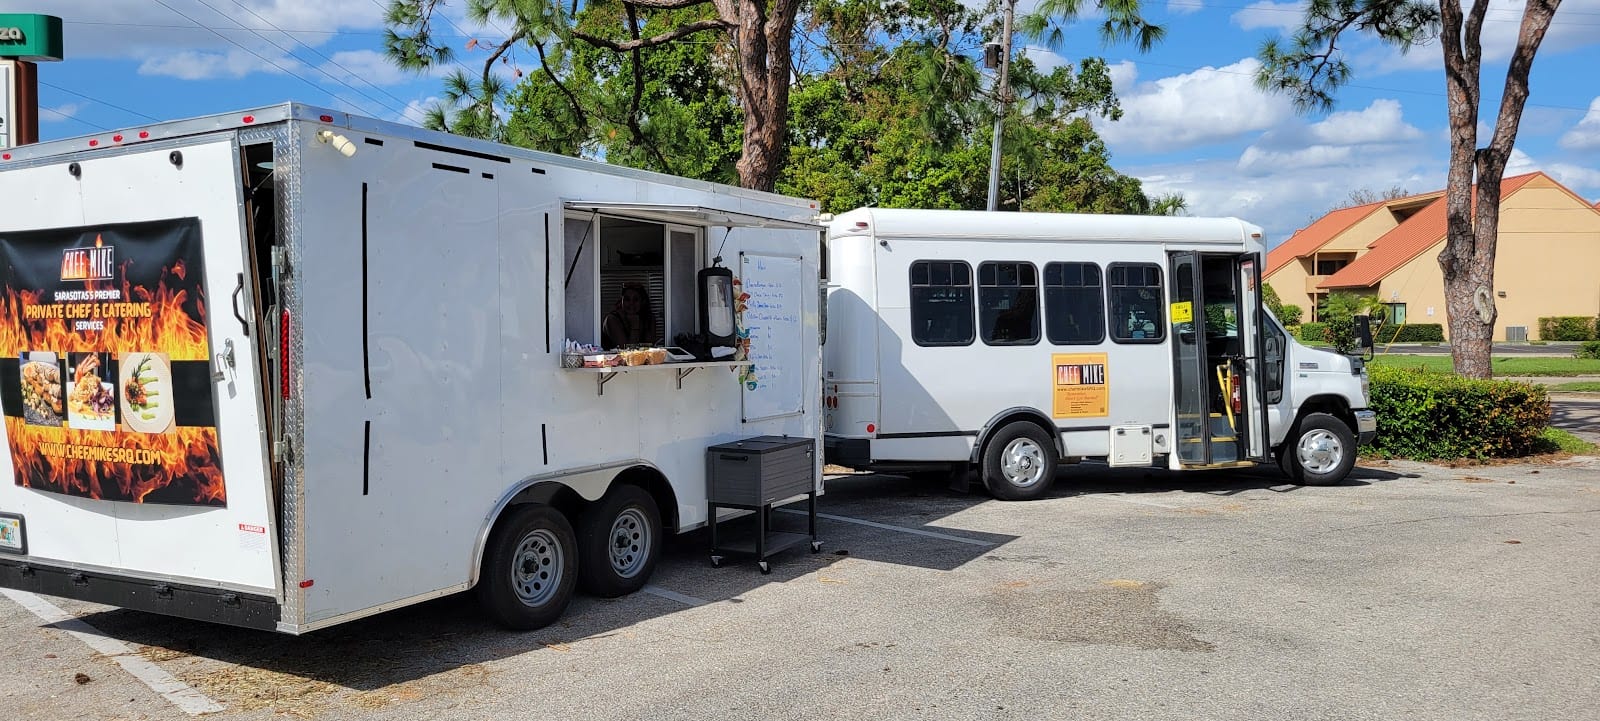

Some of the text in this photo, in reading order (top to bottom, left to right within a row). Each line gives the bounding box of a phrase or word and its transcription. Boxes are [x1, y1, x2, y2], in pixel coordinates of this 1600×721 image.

[89, 248, 113, 277] MIKE
[94, 289, 121, 300] PREMIER
[26, 302, 152, 319] PRIVATE CHEF & CATERING
[75, 320, 104, 331] SERVICES
[1057, 364, 1104, 384] CHEF MIKE
